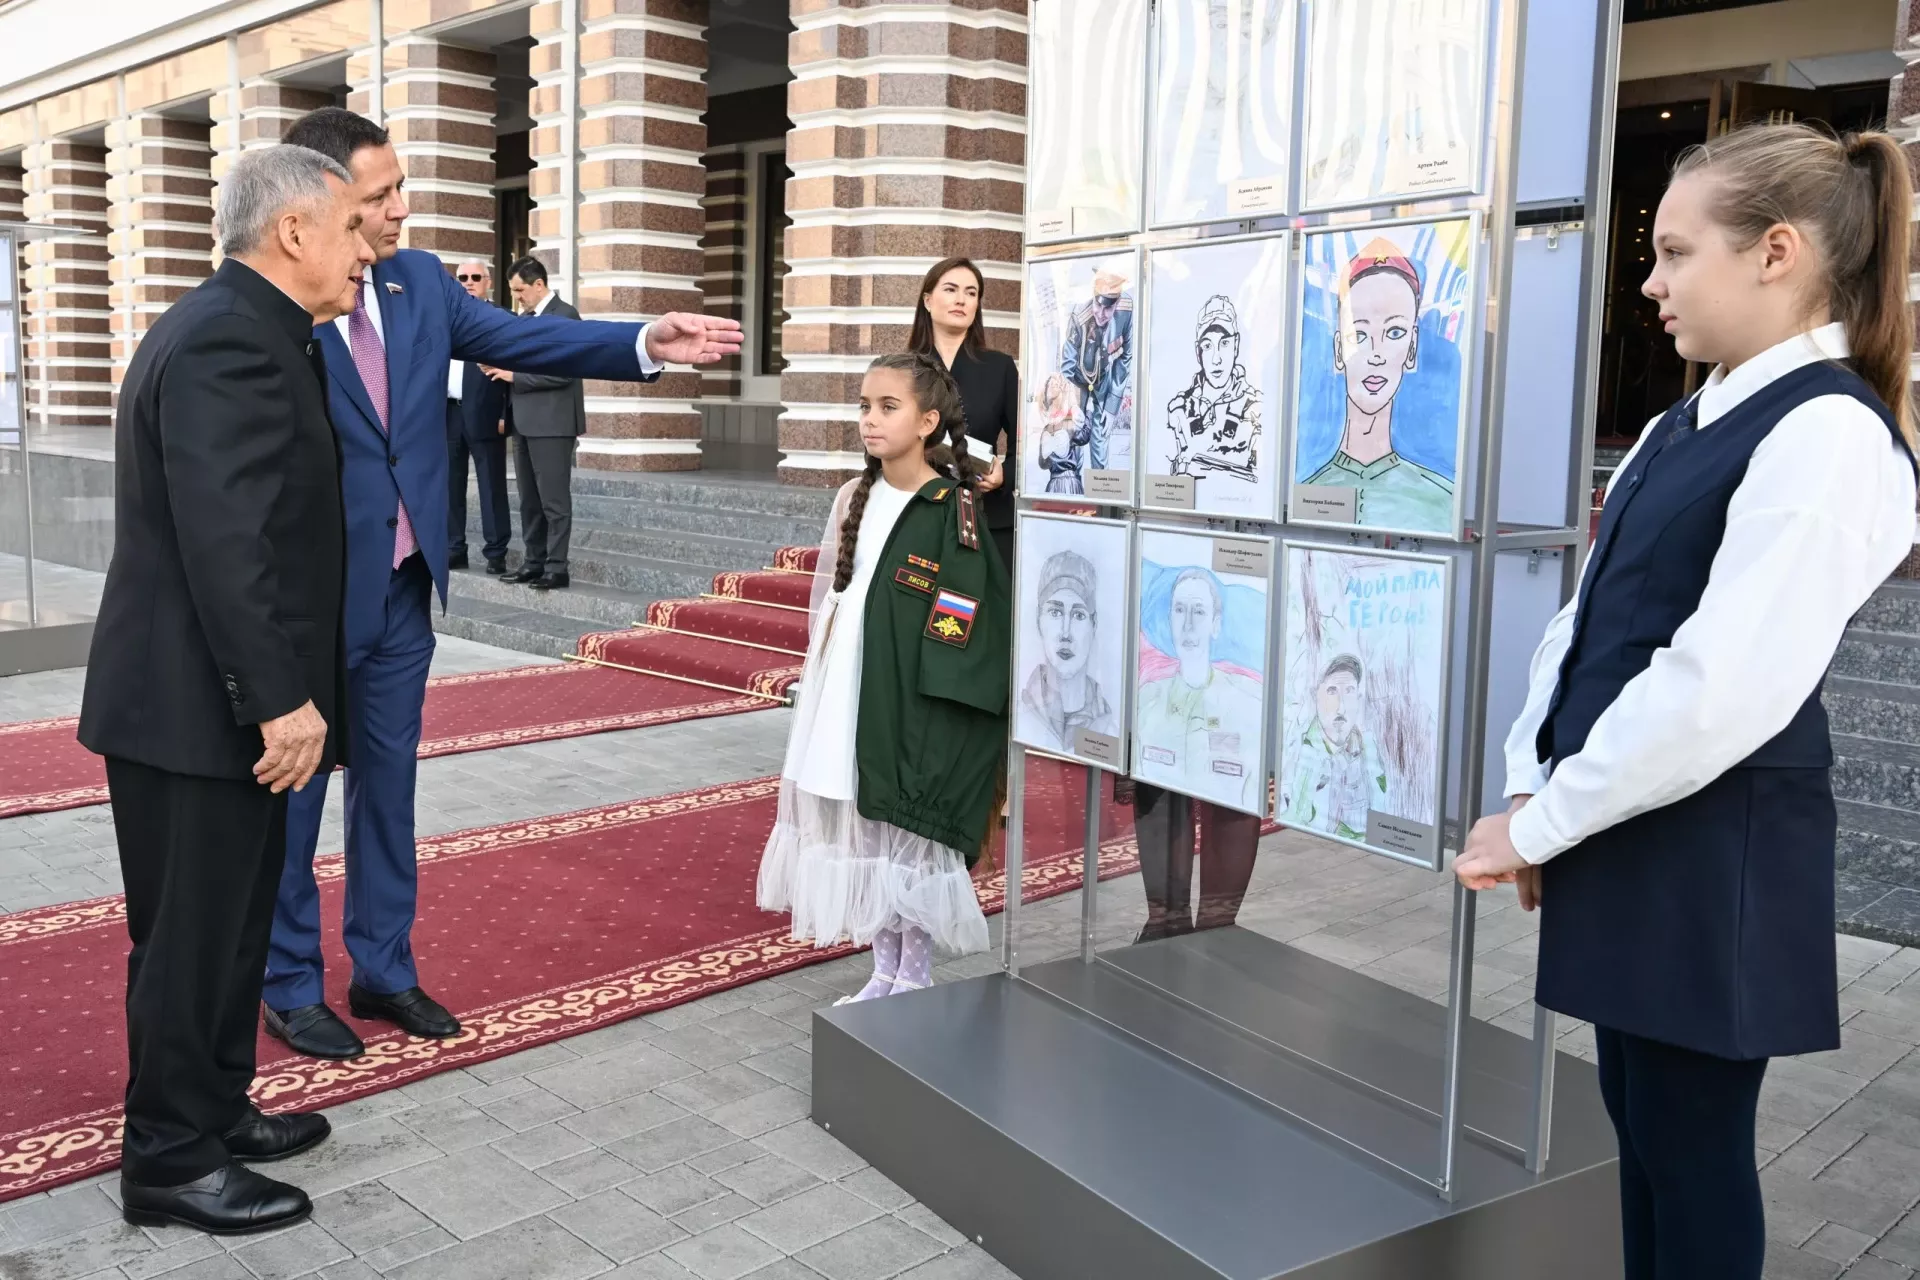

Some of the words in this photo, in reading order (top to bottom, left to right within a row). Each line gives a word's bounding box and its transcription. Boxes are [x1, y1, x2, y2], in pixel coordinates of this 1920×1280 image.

[907, 575, 929, 588] ЛИСОВ
[1344, 573, 1388, 598] МОЙ
[1391, 568, 1440, 593] ПАПА
